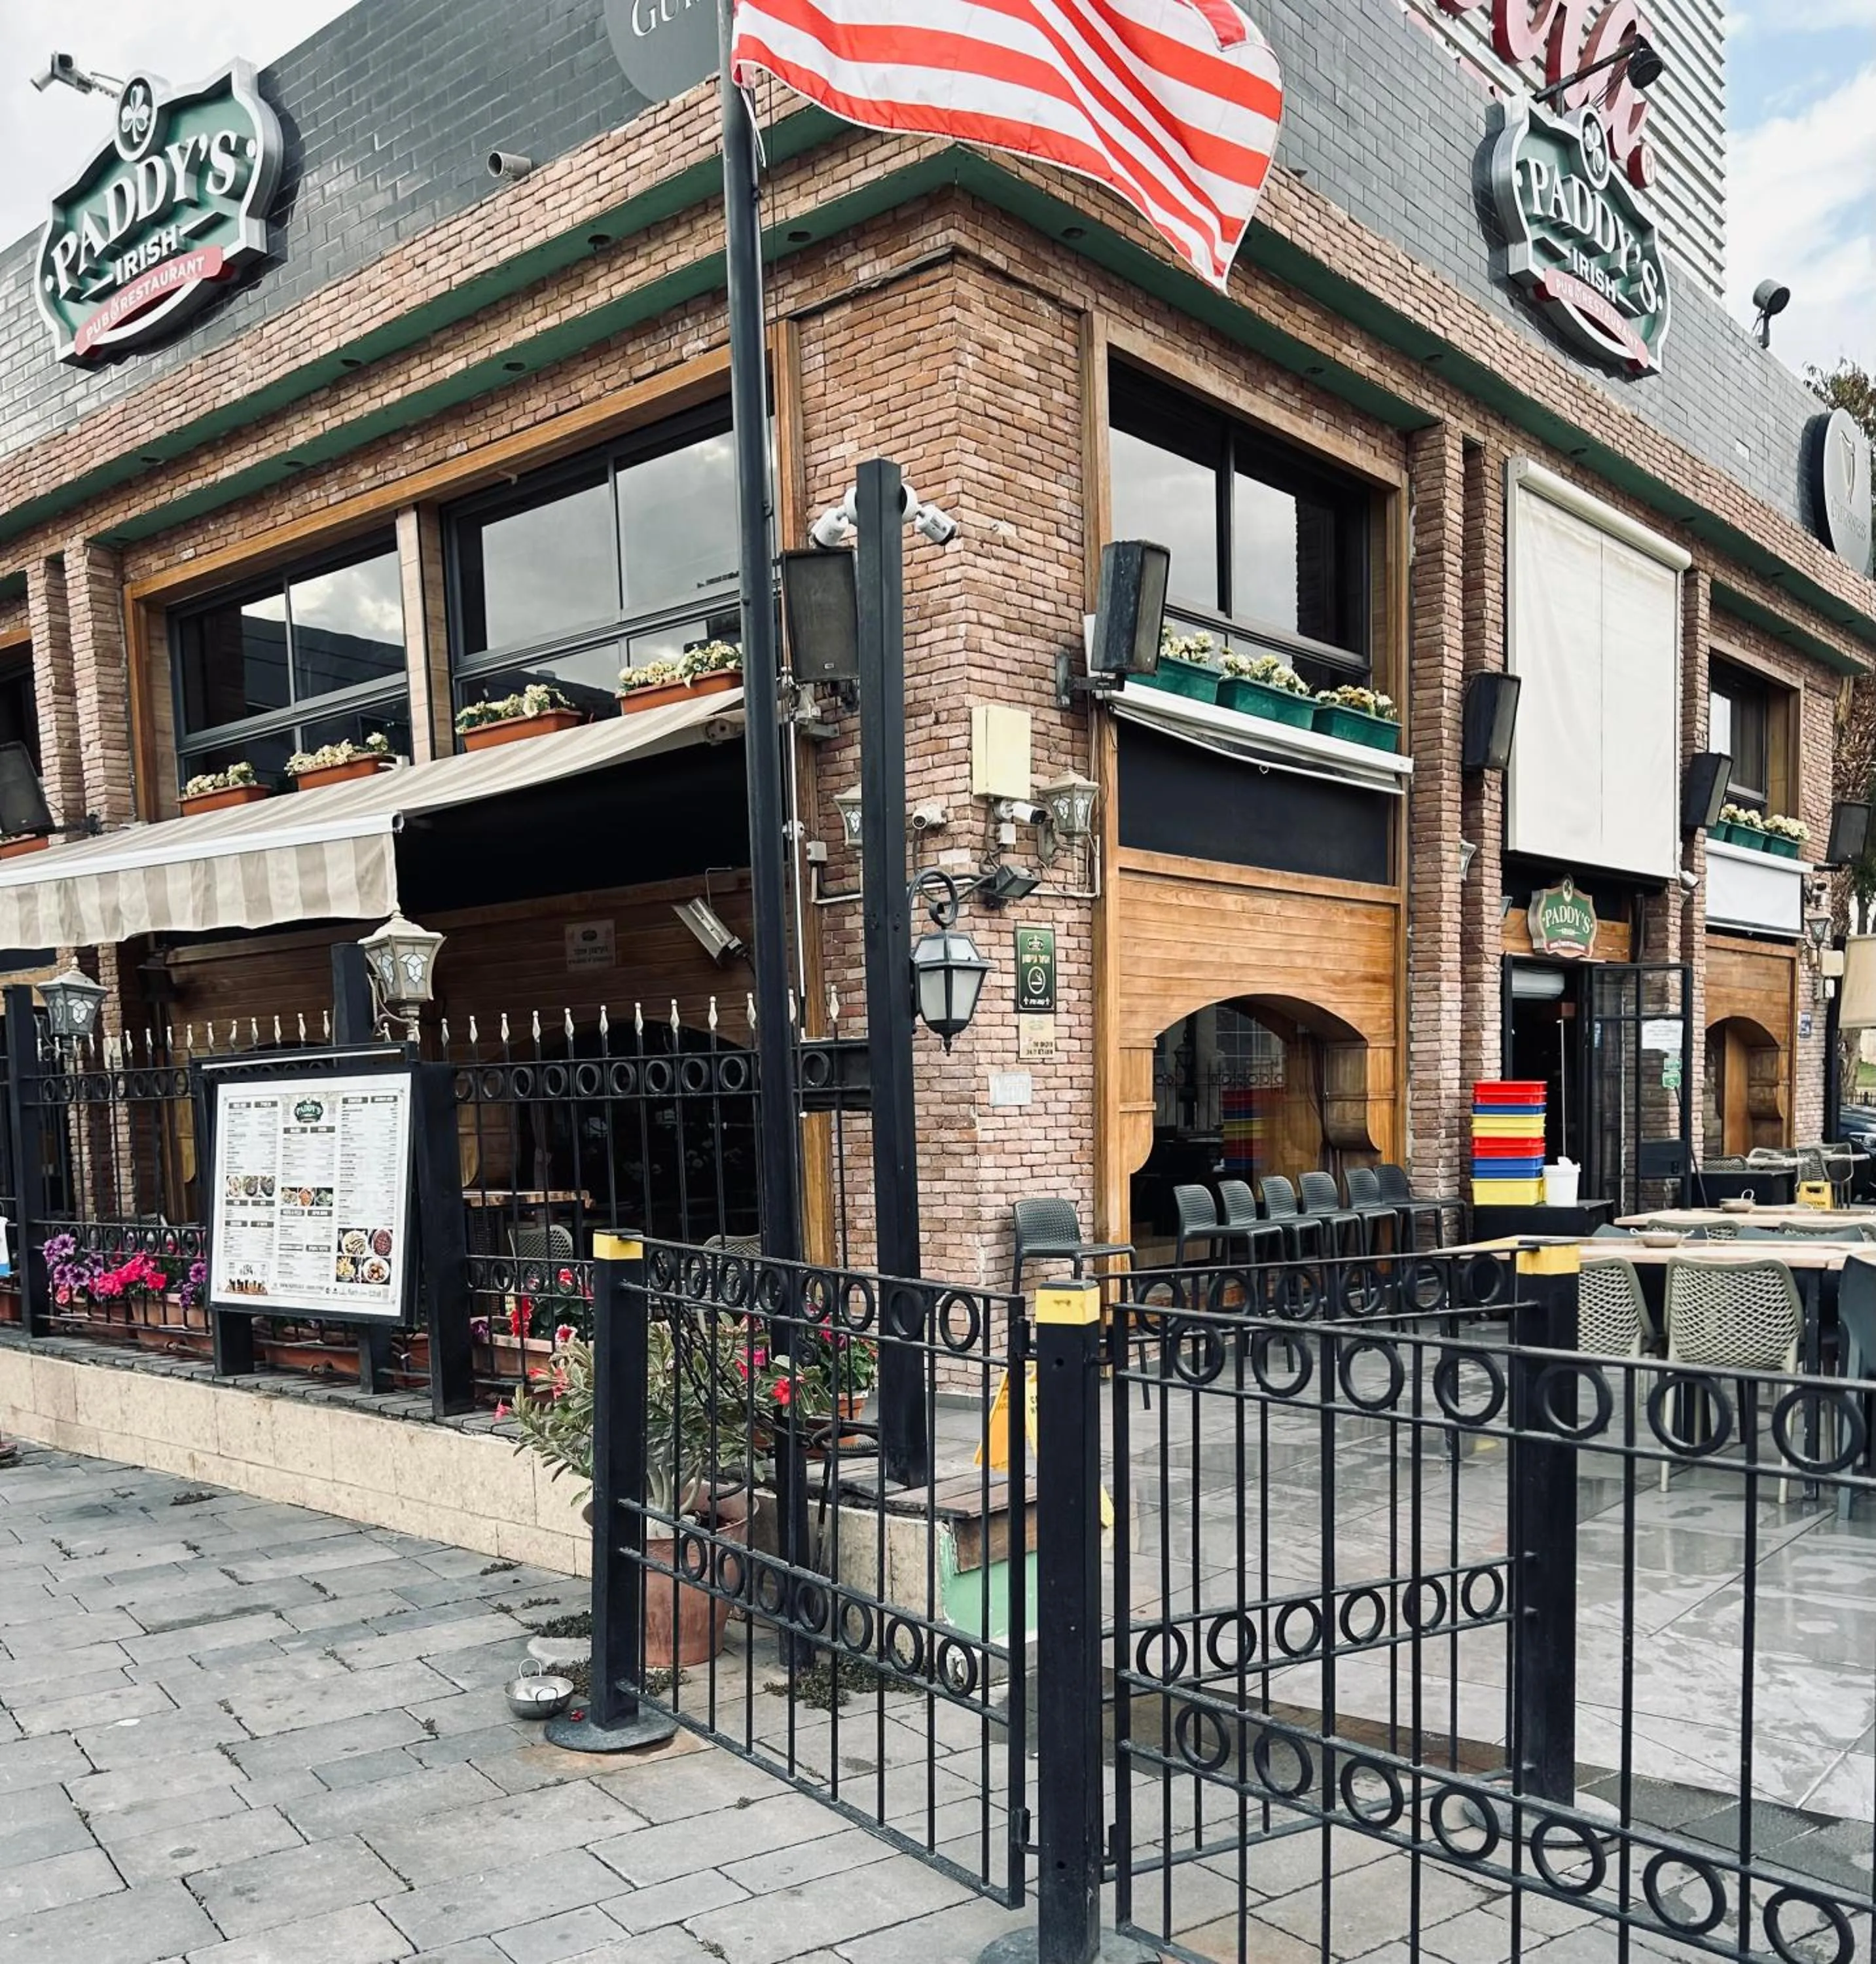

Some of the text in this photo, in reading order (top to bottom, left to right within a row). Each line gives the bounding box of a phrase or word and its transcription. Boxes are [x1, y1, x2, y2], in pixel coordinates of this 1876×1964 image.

[50, 130, 237, 300] PADDY'S
[1527, 157, 1659, 314] PADDY'S
[115, 226, 179, 286] IRISH
[1573, 247, 1616, 303] IRISH
[86, 313, 111, 341] PUB
[120, 256, 205, 312] RESTAURANT
[1555, 278, 1572, 294] PUB
[1581, 292, 1638, 348] RESTAURANT
[1545, 905, 1591, 934] PADDY'S
